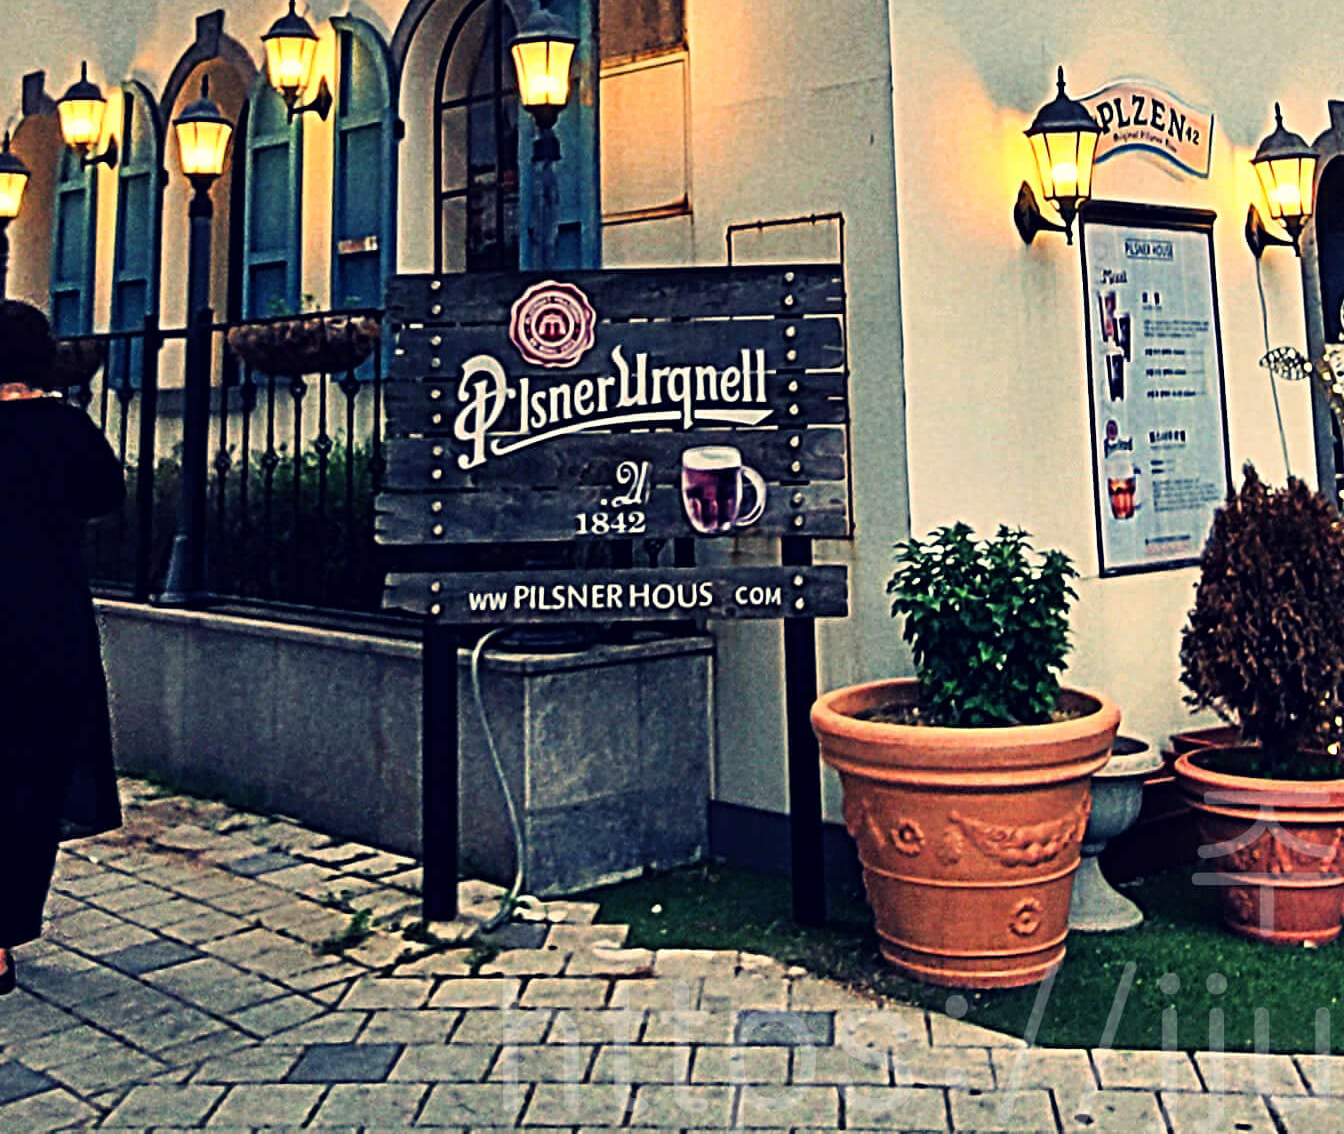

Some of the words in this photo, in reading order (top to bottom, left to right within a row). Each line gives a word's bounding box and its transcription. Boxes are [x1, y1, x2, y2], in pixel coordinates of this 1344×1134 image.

[1096, 95, 1186, 143] PLZEN
[574, 510, 646, 535] 1842
[513, 583, 623, 611] PILSNER
[629, 581, 713, 610] HOUS
[734, 585, 782, 605] COM
